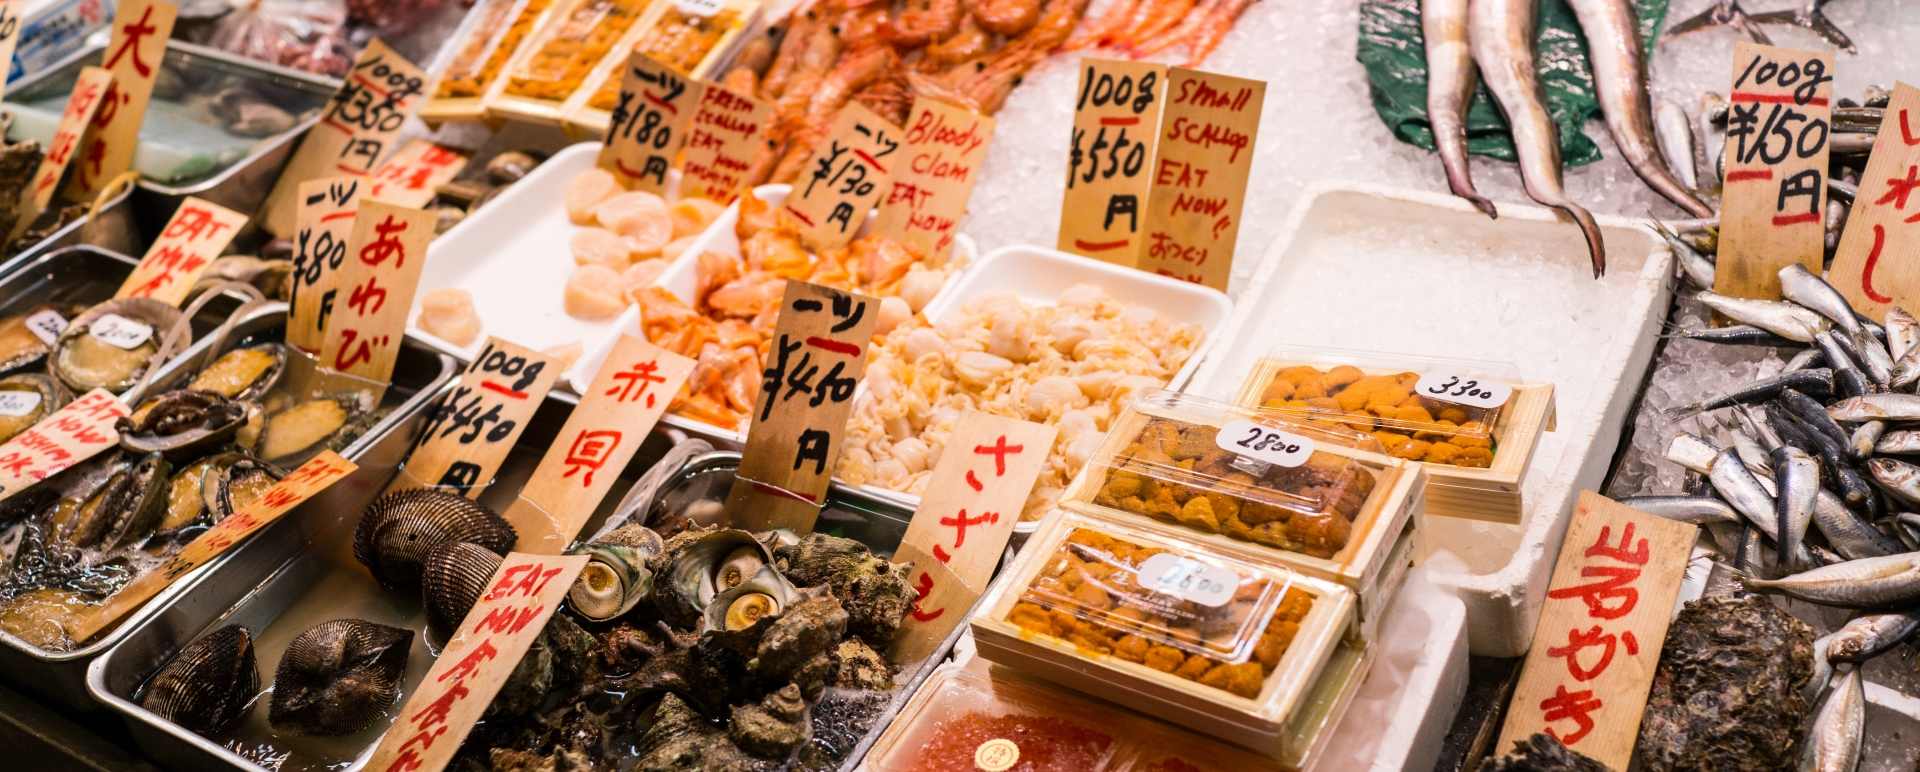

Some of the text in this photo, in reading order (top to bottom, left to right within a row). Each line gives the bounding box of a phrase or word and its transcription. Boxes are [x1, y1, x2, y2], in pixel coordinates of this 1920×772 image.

[355, 56, 422, 101] 100g
[1076, 65, 1157, 114] 100g
[1734, 54, 1833, 106] 100g
[606, 91, 671, 148] ¥180
[691, 128, 724, 152] EAT
[906, 109, 983, 156] Bloody
[1728, 102, 1829, 165] ¥150
[340, 138, 382, 169] 円
[641, 155, 668, 185] 円
[803, 140, 875, 198] ¥130
[1067, 126, 1146, 190] ¥550
[1157, 158, 1209, 189] EAT
[886, 182, 934, 209] EAT
[1104, 195, 1138, 232] 円
[1778, 169, 1821, 214] 円
[163, 207, 230, 241] EAT
[826, 202, 854, 233] 円
[289, 228, 347, 318] ¥80
[336, 215, 408, 371] あわび
[469, 343, 547, 392] 100g
[760, 334, 857, 422] ¥450
[1428, 375, 1493, 401] 3300
[44, 416, 107, 444] NOW
[63, 394, 124, 422] EAT
[420, 387, 516, 447] ¥450
[563, 360, 667, 488] 赤貝
[793, 429, 830, 476] 円
[1236, 427, 1300, 454] 2800
[434, 461, 482, 497] 円
[484, 563, 563, 603] EAT
[473, 605, 544, 635] NOW
[1540, 521, 1650, 746] 岩かき
